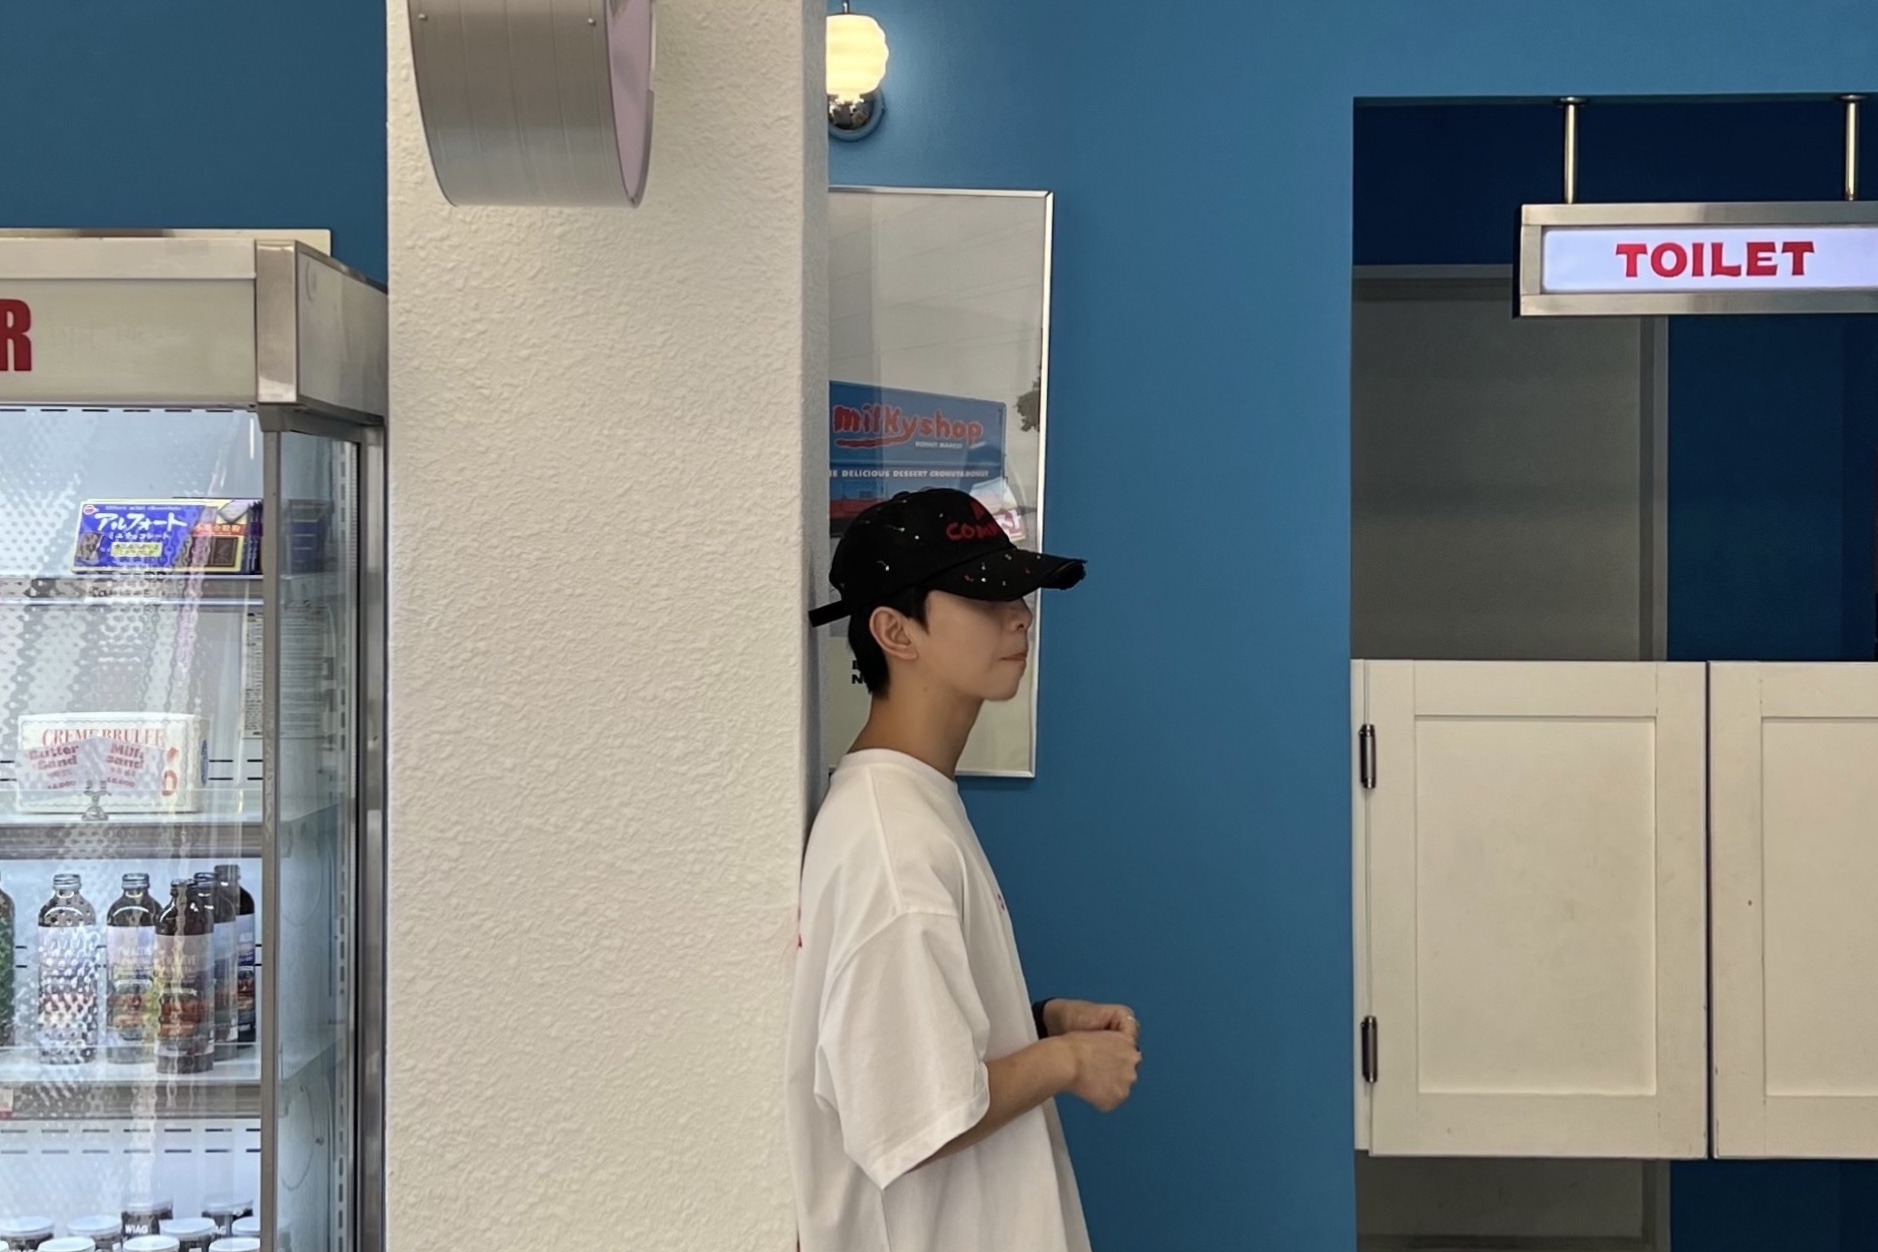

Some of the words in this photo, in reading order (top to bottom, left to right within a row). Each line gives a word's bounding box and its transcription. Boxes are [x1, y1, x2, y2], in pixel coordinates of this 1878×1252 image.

[1615, 241, 1815, 278] TOILET
[832, 402, 984, 449] milkyshop
[842, 470, 890, 478] DELICIOUS
[892, 470, 928, 478] DESSERT
[94, 512, 188, 532] アルフォート
